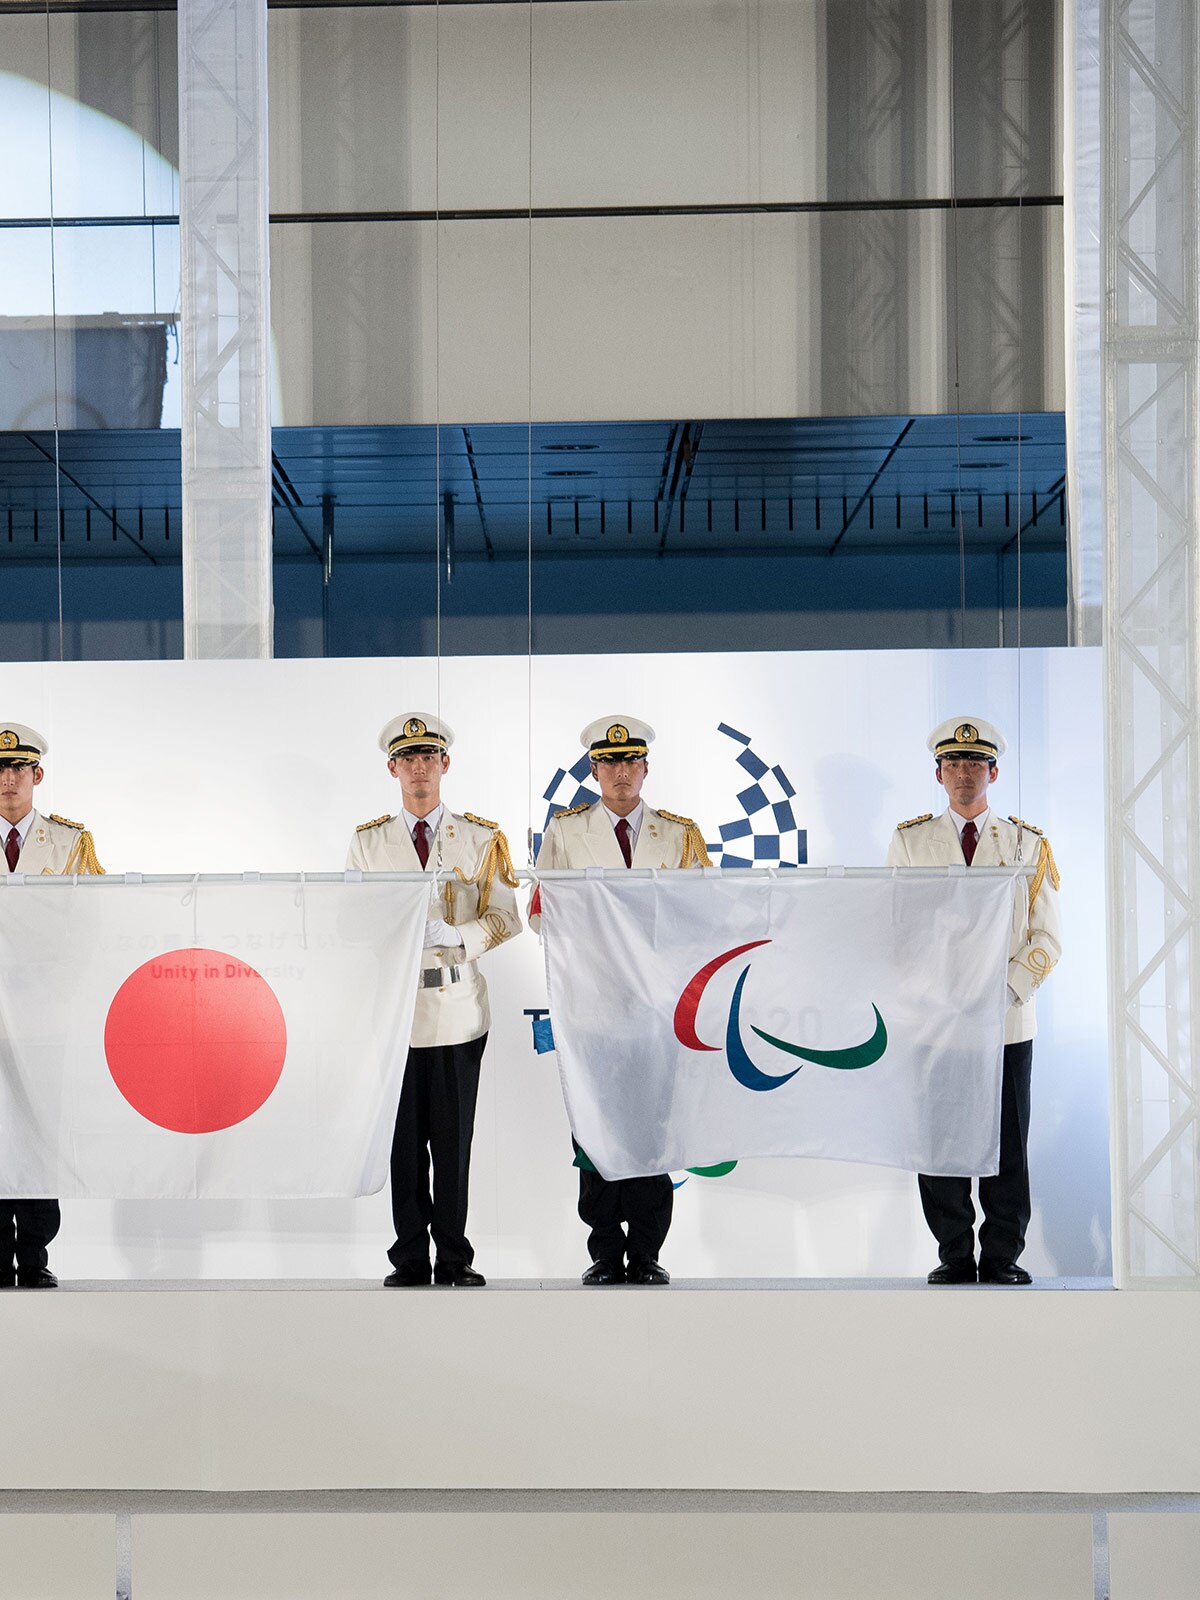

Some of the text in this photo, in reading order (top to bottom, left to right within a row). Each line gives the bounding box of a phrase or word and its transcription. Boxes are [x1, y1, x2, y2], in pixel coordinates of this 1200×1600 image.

[150, 963, 305, 982] Unity in Diversity
